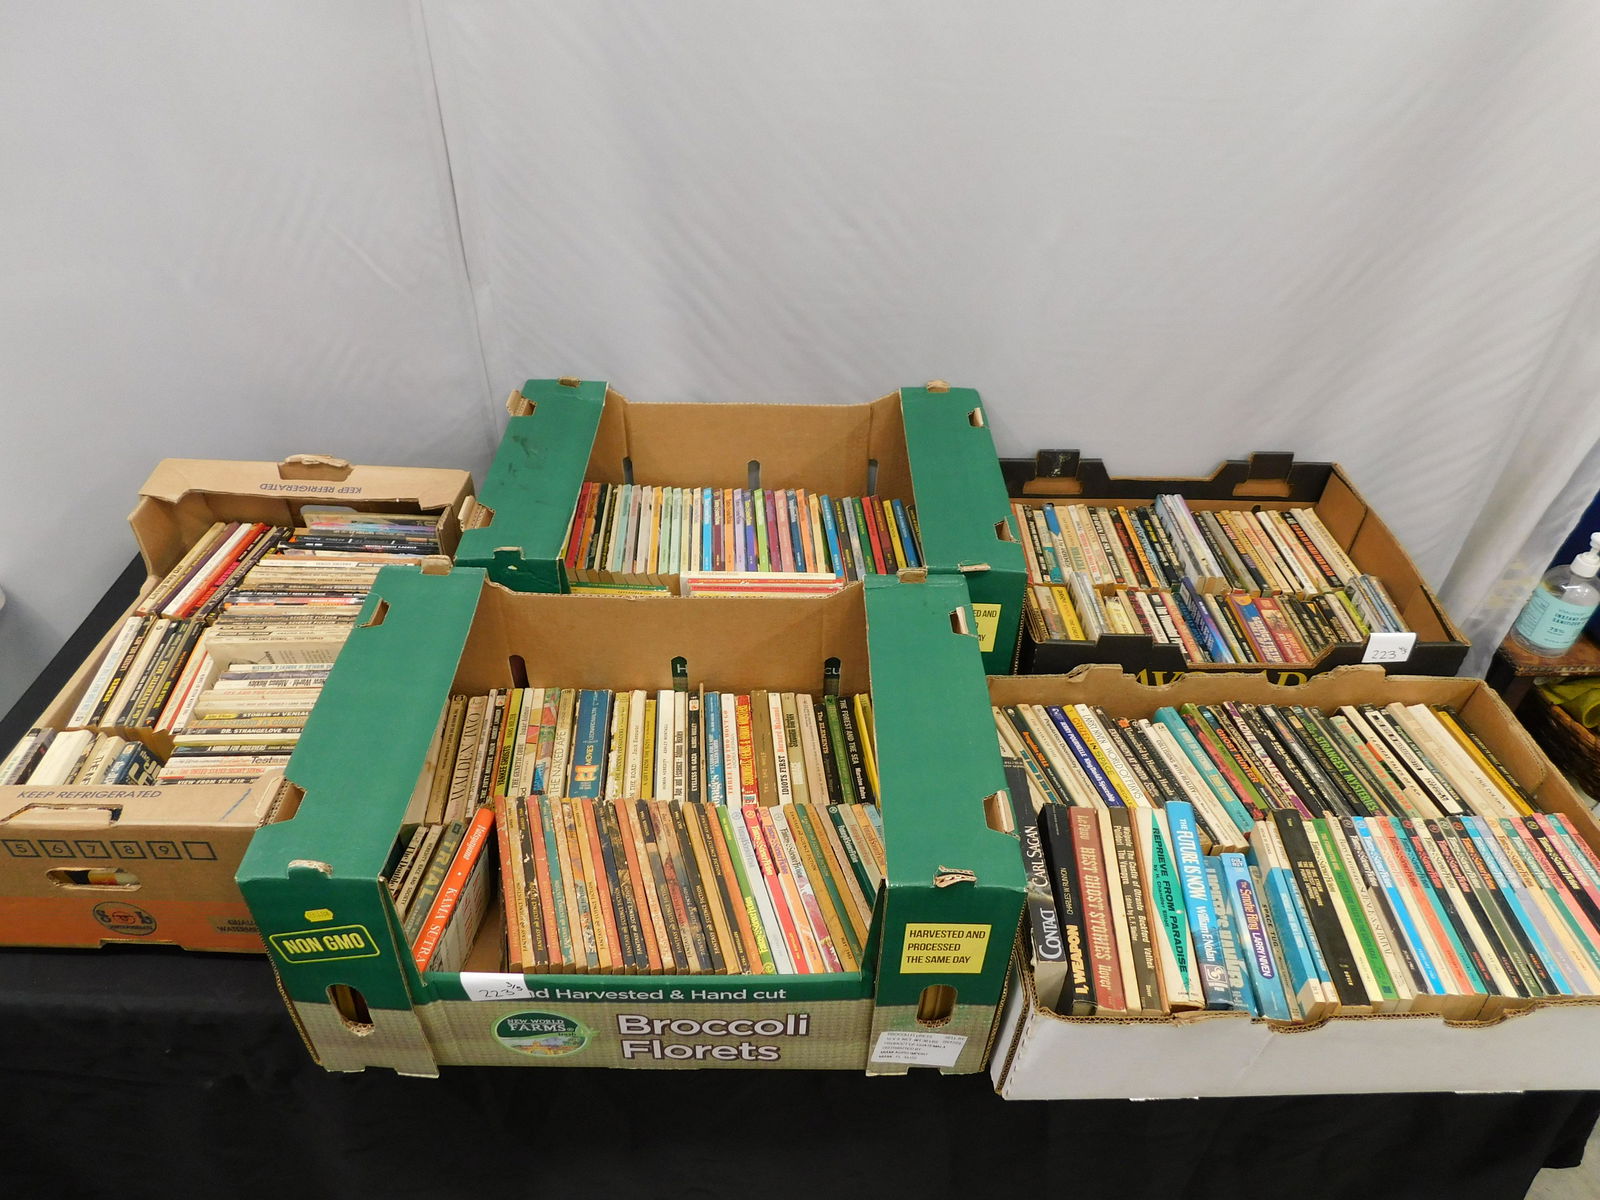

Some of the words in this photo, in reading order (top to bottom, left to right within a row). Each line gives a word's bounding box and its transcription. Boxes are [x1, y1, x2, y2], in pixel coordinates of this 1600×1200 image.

[260, 483, 334, 493] REFRIGERATED
[1372, 649, 1396, 659] 223
[839, 699, 847, 709] THE
[815, 711, 824, 721] The
[841, 709, 852, 730] FOREST
[555, 730, 565, 745] APE
[817, 721, 830, 754] ELEMENTS
[845, 729, 854, 742] AND
[1071, 715, 1093, 744] CITIZEN
[1123, 726, 1146, 755] Untouched
[848, 742, 856, 753] THE
[1081, 712, 1096, 729] LARRY
[1091, 726, 1107, 745] NIVEN
[1104, 746, 1123, 770] WORLD
[1117, 767, 1129, 780] OF
[1089, 741, 1098, 750] IN
[1107, 726, 1133, 759] EXPERIMENT
[450, 742, 474, 802] WALDEN
[464, 711, 481, 739] TWO
[500, 743, 511, 766] GHOSTS
[552, 748, 563, 776] NAKED
[777, 754, 786, 773] FIRST
[850, 753, 859, 764] SEA
[1058, 720, 1071, 735] JERRY
[1066, 732, 1087, 757] POURNELLE
[1096, 779, 1116, 803] Spaceship
[1093, 749, 1115, 776] SPACE
[1141, 751, 1150, 761] by
[1215, 727, 1236, 754] GHOST
[1233, 752, 1258, 784] HUNTER
[1232, 714, 1255, 741] ALONE
[1251, 741, 1266, 759] BY
[1261, 755, 1296, 798] NIGHT
[497, 765, 507, 785] YANKEE
[512, 756, 522, 777] GENETIC
[1145, 758, 1162, 779] Human
[1315, 734, 1349, 774] STRANGEST
[1343, 771, 1378, 812] MYSTERIES
[1390, 760, 1403, 775] TALES
[1403, 776, 1411, 784] OF
[17, 791, 53, 799] KEEP
[57, 790, 163, 799] REFRIGERATED
[550, 777, 560, 793] THE
[780, 773, 789, 795] IDIOTS
[1158, 777, 1174, 797] Hands
[1181, 774, 1195, 794] REALITY
[1179, 818, 1188, 829] THE
[17, 845, 27, 854] 5
[53, 845, 62, 854] 6
[88, 845, 97, 854] 7
[124, 845, 134, 854] 8
[159, 845, 169, 854] 9
[699, 814, 709, 834] FANTASY
[707, 840, 716, 858] SCIENCE
[712, 858, 721, 876] FICTION
[1021, 823, 1041, 859] SAGAN
[1176, 828, 1199, 865] FUTURE
[1078, 845, 1097, 874] BEST
[1117, 849, 1126, 860] The
[1126, 849, 1134, 860] The
[419, 838, 456, 902] TRIAL
[1028, 859, 1047, 888] CARL
[1119, 860, 1131, 884] Vampyre
[1128, 861, 1138, 879] Castle
[1183, 863, 1201, 874] IS
[528, 880, 536, 899] FICTION
[614, 887, 622, 905] FICTION
[624, 885, 632, 904] FICTION
[696, 884, 705, 903] FICTION
[1083, 873, 1103, 911] GHOST
[1133, 887, 1144, 911] Otranto
[1155, 880, 1167, 908] Chandler
[1185, 872, 1206, 903] NOW
[434, 885, 458, 921] KAMA
[531, 900, 539, 920] SCIENCE
[1063, 891, 1073, 915] CHARLES
[1152, 826, 1167, 877] REPRIEVE
[1161, 879, 1175, 912] FROM
[1169, 914, 1188, 973] PARADISE
[1239, 887, 1256, 913] Smoke
[628, 904, 636, 923] SCIENCE
[701, 904, 711, 923] SCIENCE
[1195, 905, 1211, 934] William
[1245, 911, 1261, 931] Ring
[909, 930, 964, 940] HARVESTED
[966, 930, 986, 940] AND
[1038, 905, 1062, 960] CONTACT
[1089, 909, 1111, 961] STORIES
[1138, 914, 1150, 943] Beckford
[1262, 904, 1272, 928] SPACE
[1269, 931, 1278, 947] TUG
[282, 937, 324, 957] NON
[323, 932, 365, 952] GMO
[415, 922, 441, 965] SUTRA
[534, 928, 543, 950] FANTASY
[623, 934, 631, 957] FANTASY
[633, 932, 642, 955] FANTASY
[709, 931, 719, 954] FANTASY
[907, 943, 961, 952] PROCESSED
[1202, 938, 1217, 962] Nolan
[1251, 931, 1265, 956] LARRY
[906, 956, 923, 965] THE
[924, 956, 947, 965] SAME
[949, 956, 970, 965] DAY
[1065, 923, 1086, 983] WEAPON
[1144, 946, 1155, 969] Vathek
[1257, 954, 1271, 977] NIVEN
[479, 990, 512, 999] 223
[557, 988, 639, 1000] Harvested
[670, 988, 684, 1000] &
[691, 988, 731, 1000] Hand
[753, 988, 786, 1000] cut
[510, 1024, 566, 1032] FARMS
[616, 1013, 809, 1038] Broccoli
[620, 1038, 780, 1061] Florets
